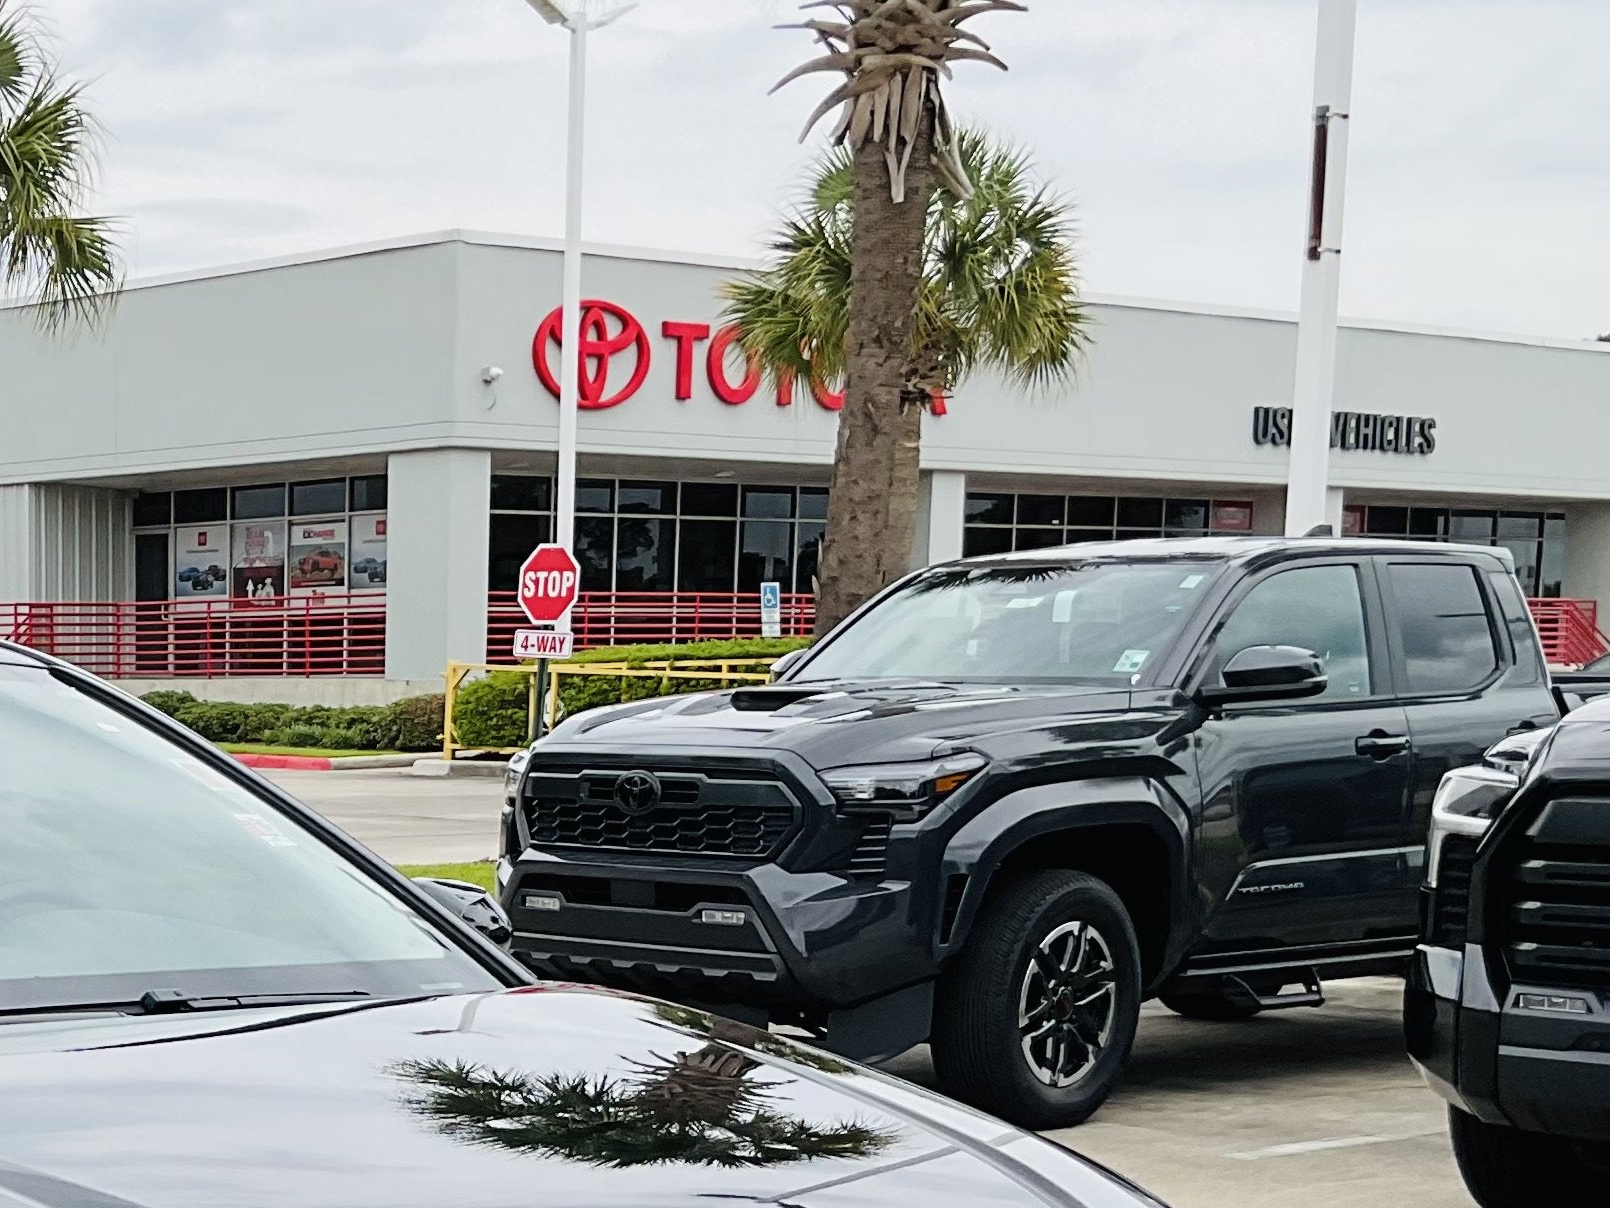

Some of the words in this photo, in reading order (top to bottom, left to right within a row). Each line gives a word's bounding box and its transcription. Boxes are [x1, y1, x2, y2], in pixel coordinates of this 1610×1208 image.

[661, 321, 947, 417] TOY
[1253, 406, 1293, 447] US
[1329, 411, 1436, 454] VEHICLES
[523, 570, 574, 598] STOP
[520, 635, 566, 654] 4-WAY
